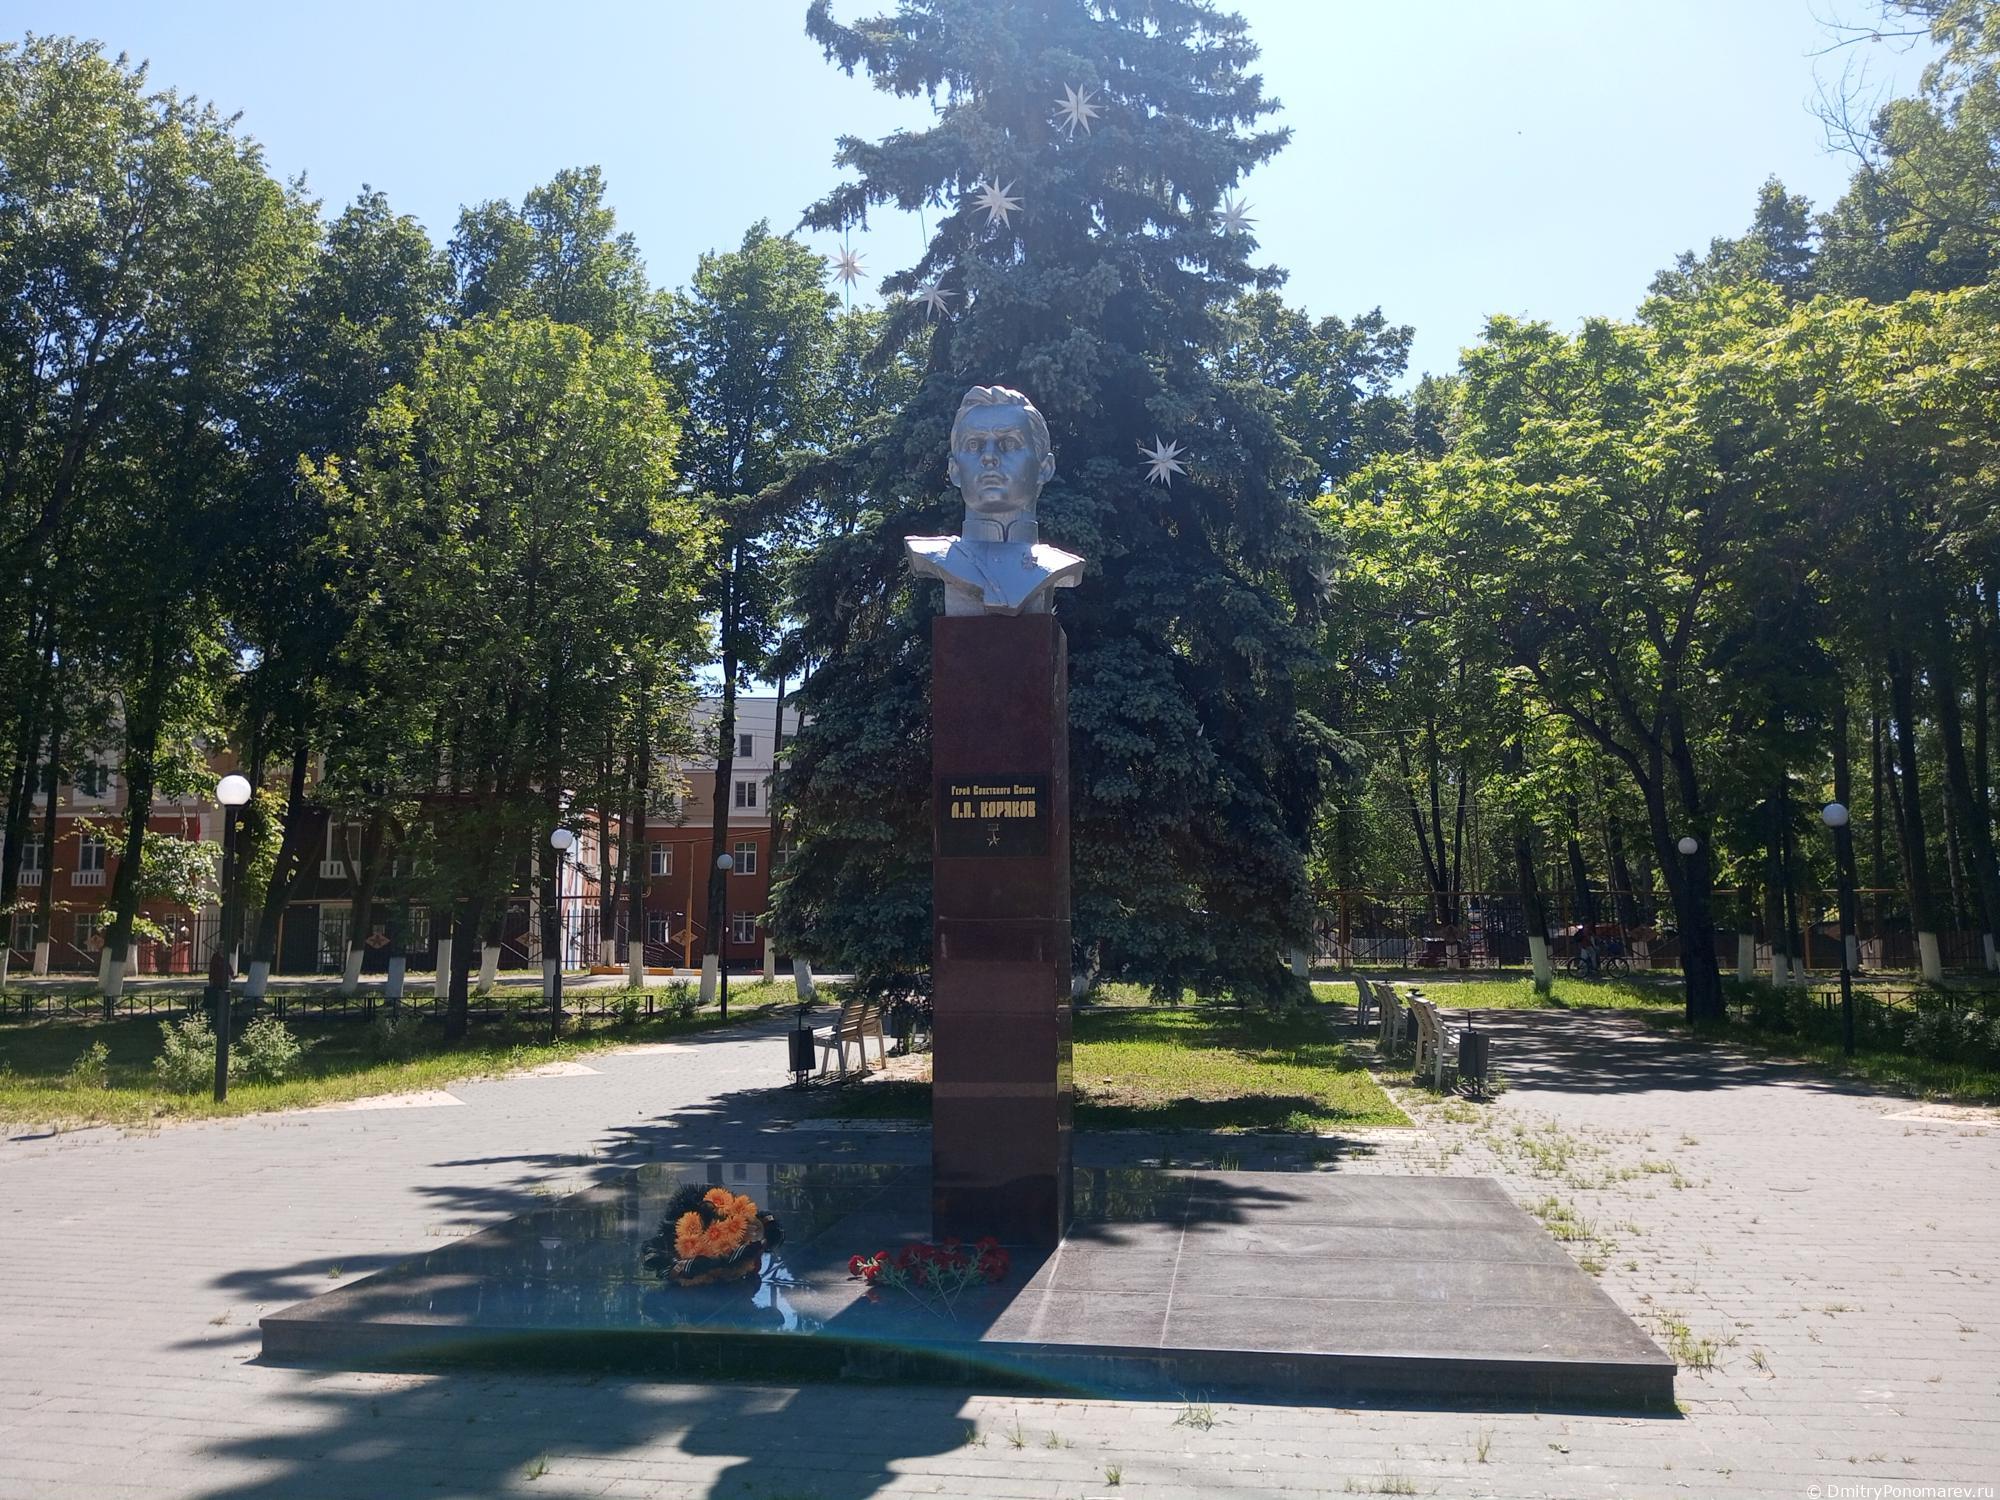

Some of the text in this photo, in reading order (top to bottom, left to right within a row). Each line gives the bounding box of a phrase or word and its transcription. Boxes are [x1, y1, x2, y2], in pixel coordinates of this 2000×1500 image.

[951, 784, 1036, 796] Герой Советского Союза
[980, 800, 1036, 818] КОРЯКОВ
